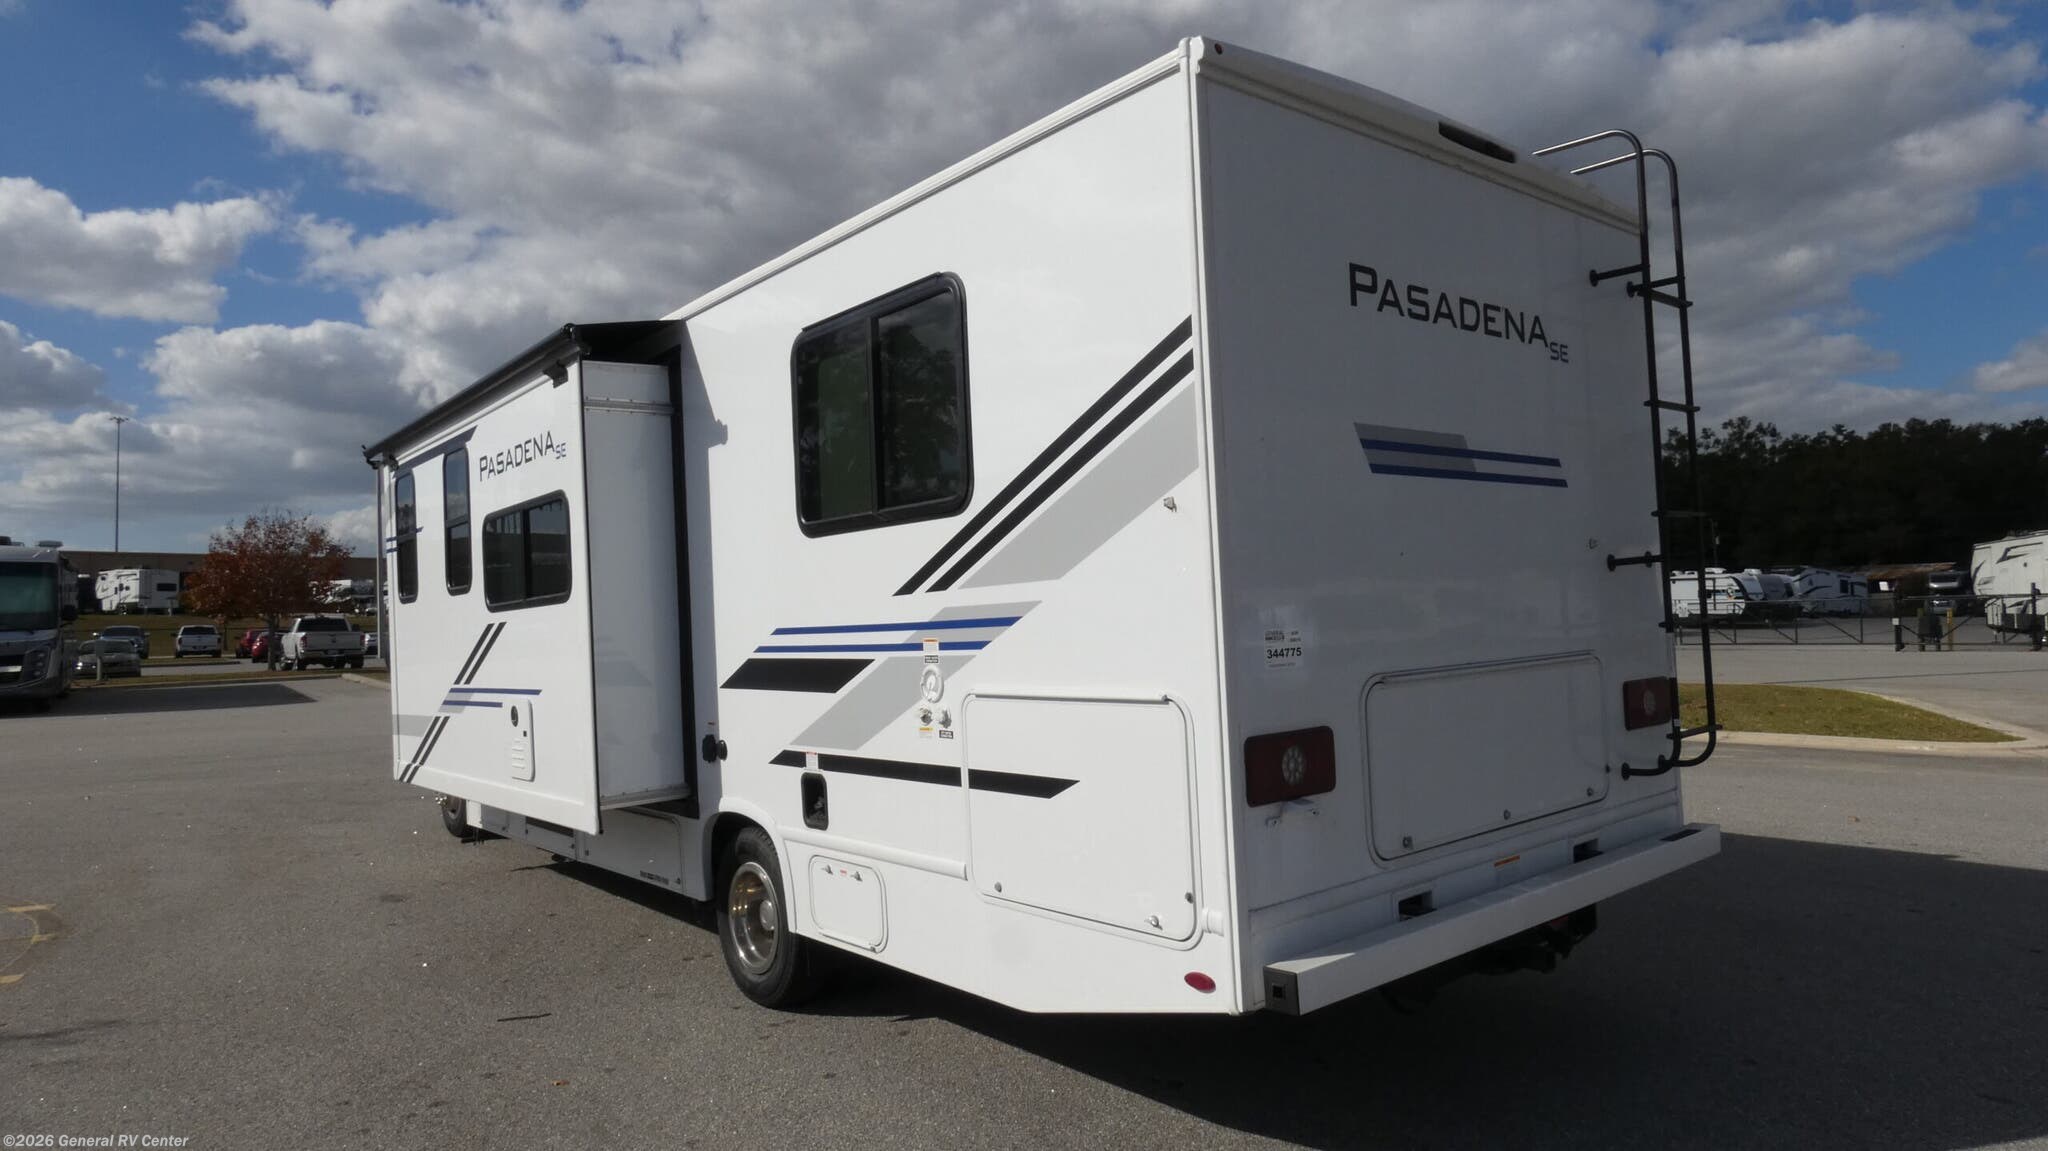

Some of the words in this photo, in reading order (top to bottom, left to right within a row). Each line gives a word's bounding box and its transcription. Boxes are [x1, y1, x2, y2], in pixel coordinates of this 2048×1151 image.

[1348, 262, 1549, 348] PASADENA
[1549, 342, 1569, 363] SE
[479, 430, 555, 482] PASADENA
[555, 442, 567, 459] SE
[1266, 647, 1302, 659] 344775
